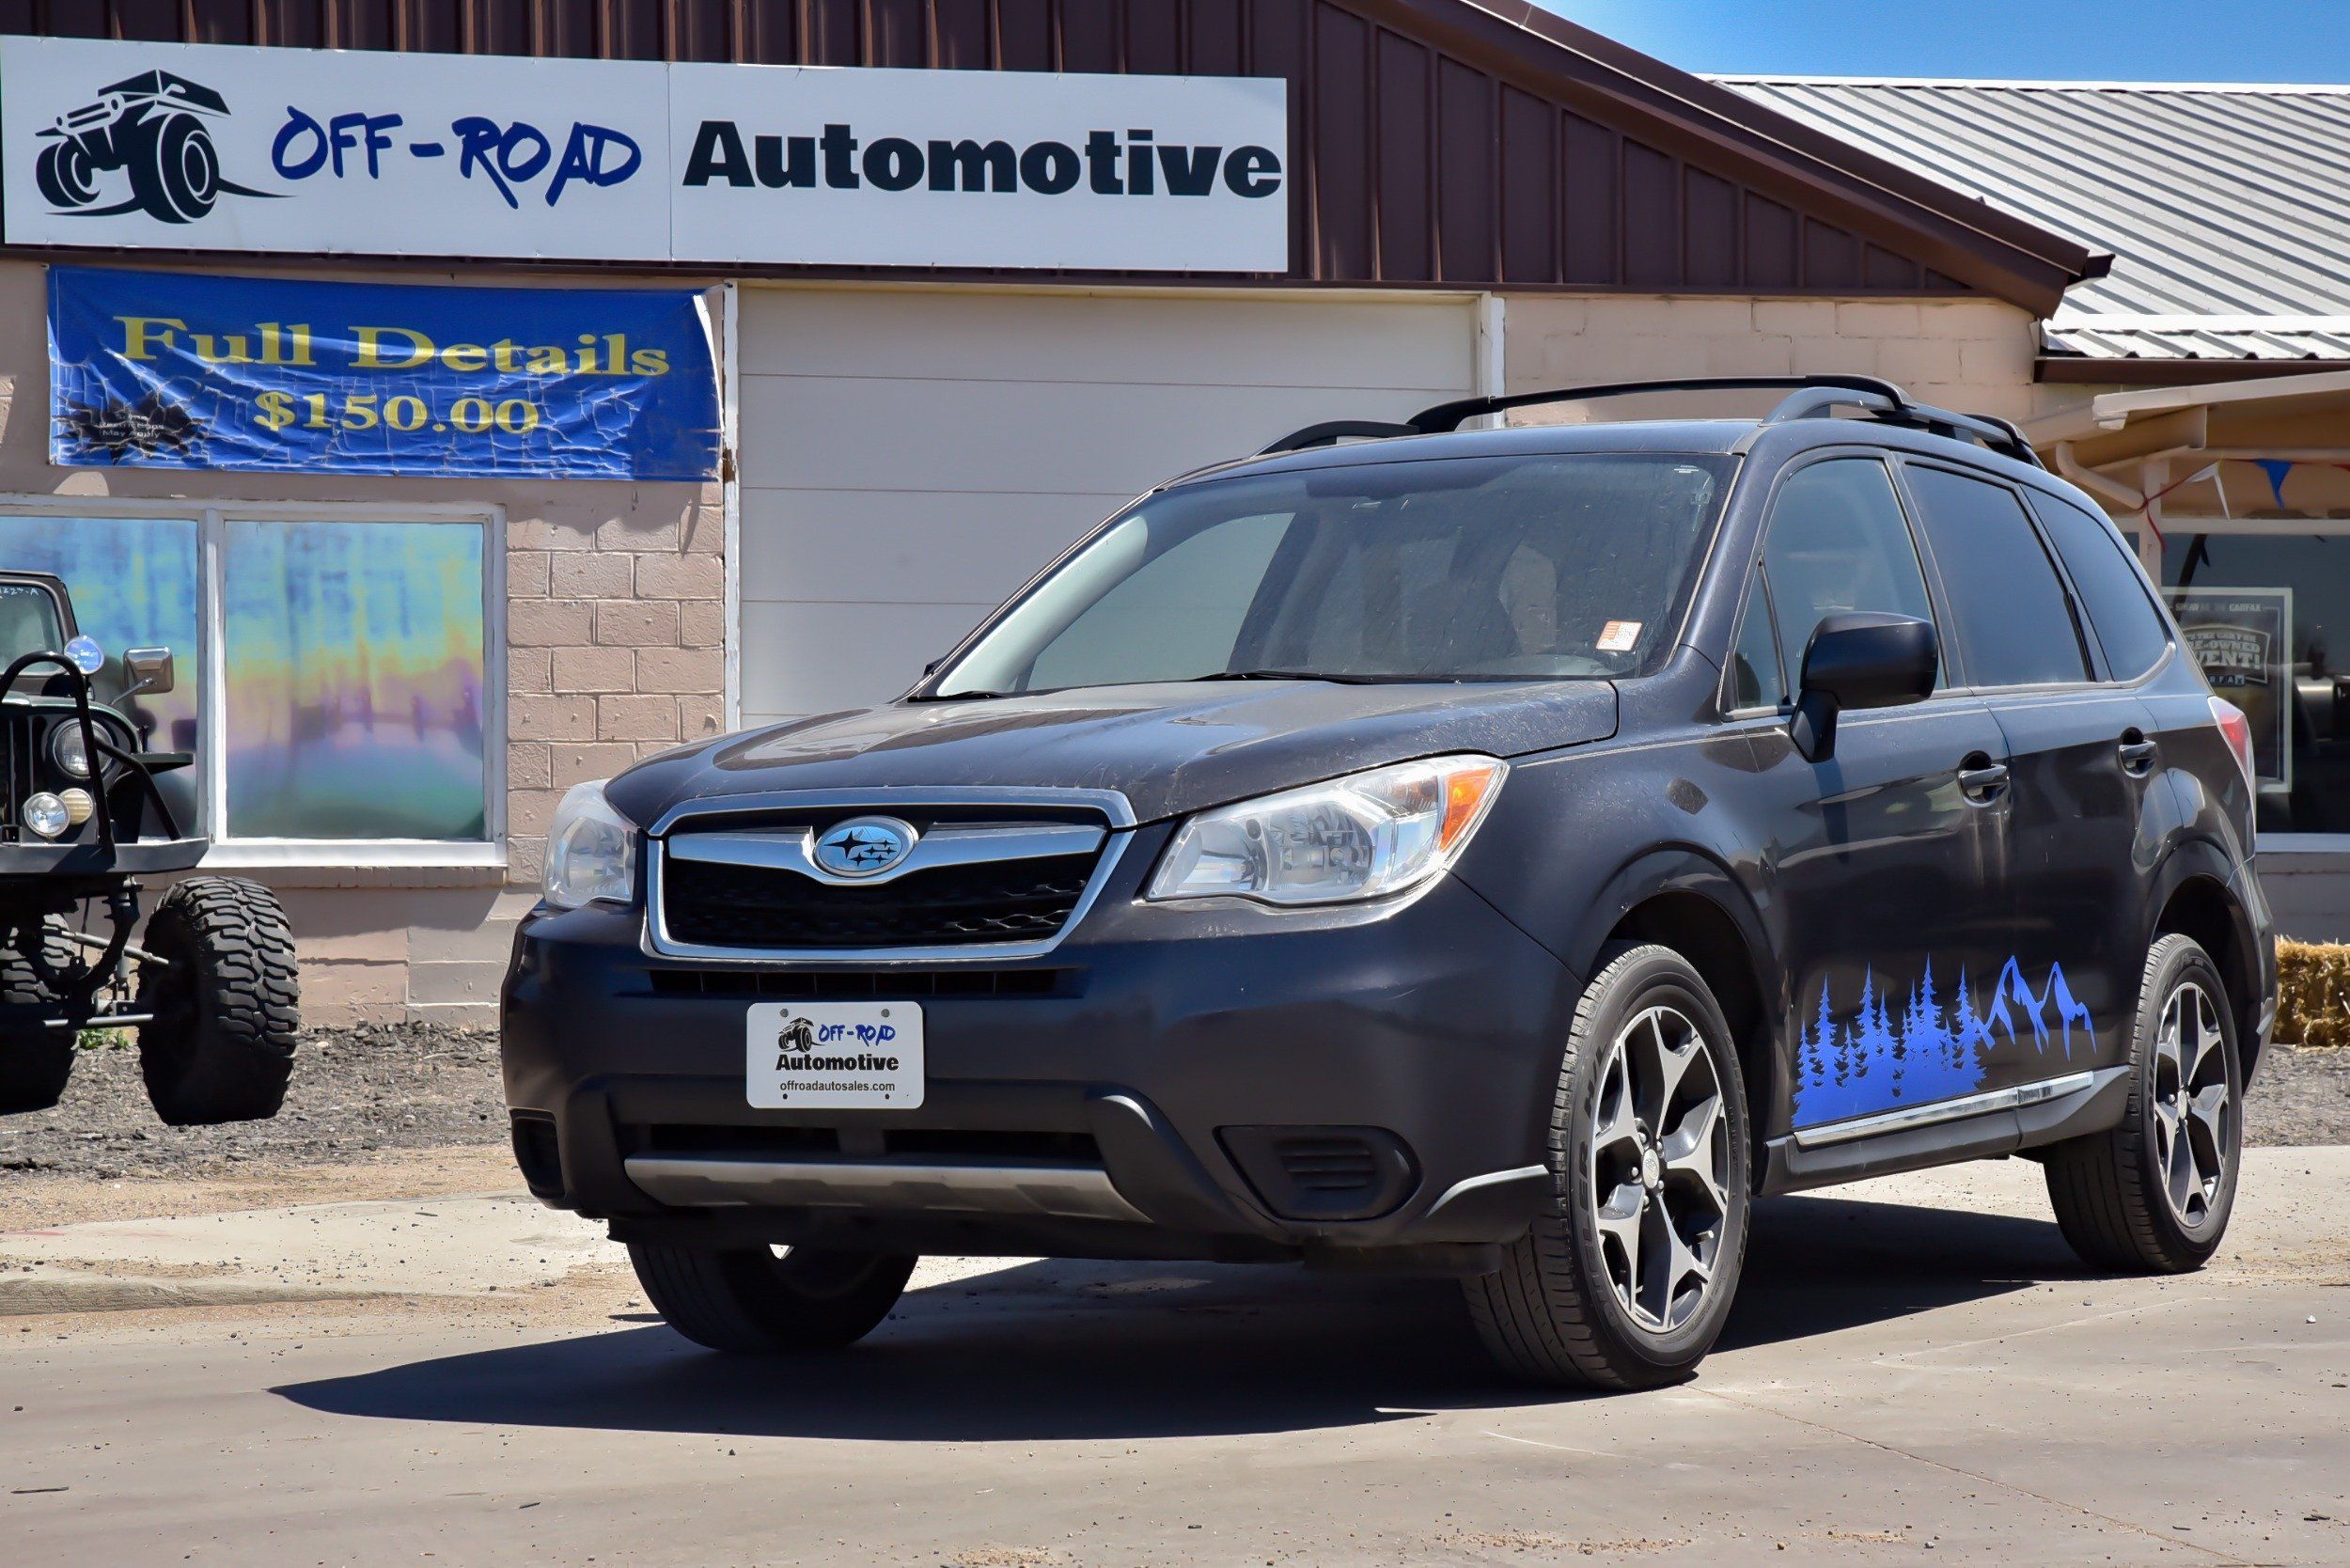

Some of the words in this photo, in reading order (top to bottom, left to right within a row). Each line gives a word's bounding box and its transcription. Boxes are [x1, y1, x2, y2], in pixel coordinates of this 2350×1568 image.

[272, 104, 642, 210] OFF-ROAD
[682, 119, 1282, 198] Automotive
[113, 316, 318, 367] Full
[348, 325, 670, 377] Details
[253, 391, 540, 435] $150.00
[2196, 649, 2261, 670] VENT!
[818, 1024, 896, 1047] OFF-ROAD
[775, 1053, 900, 1072] Automotive
[779, 1080, 896, 1092] offroadautosales.com
